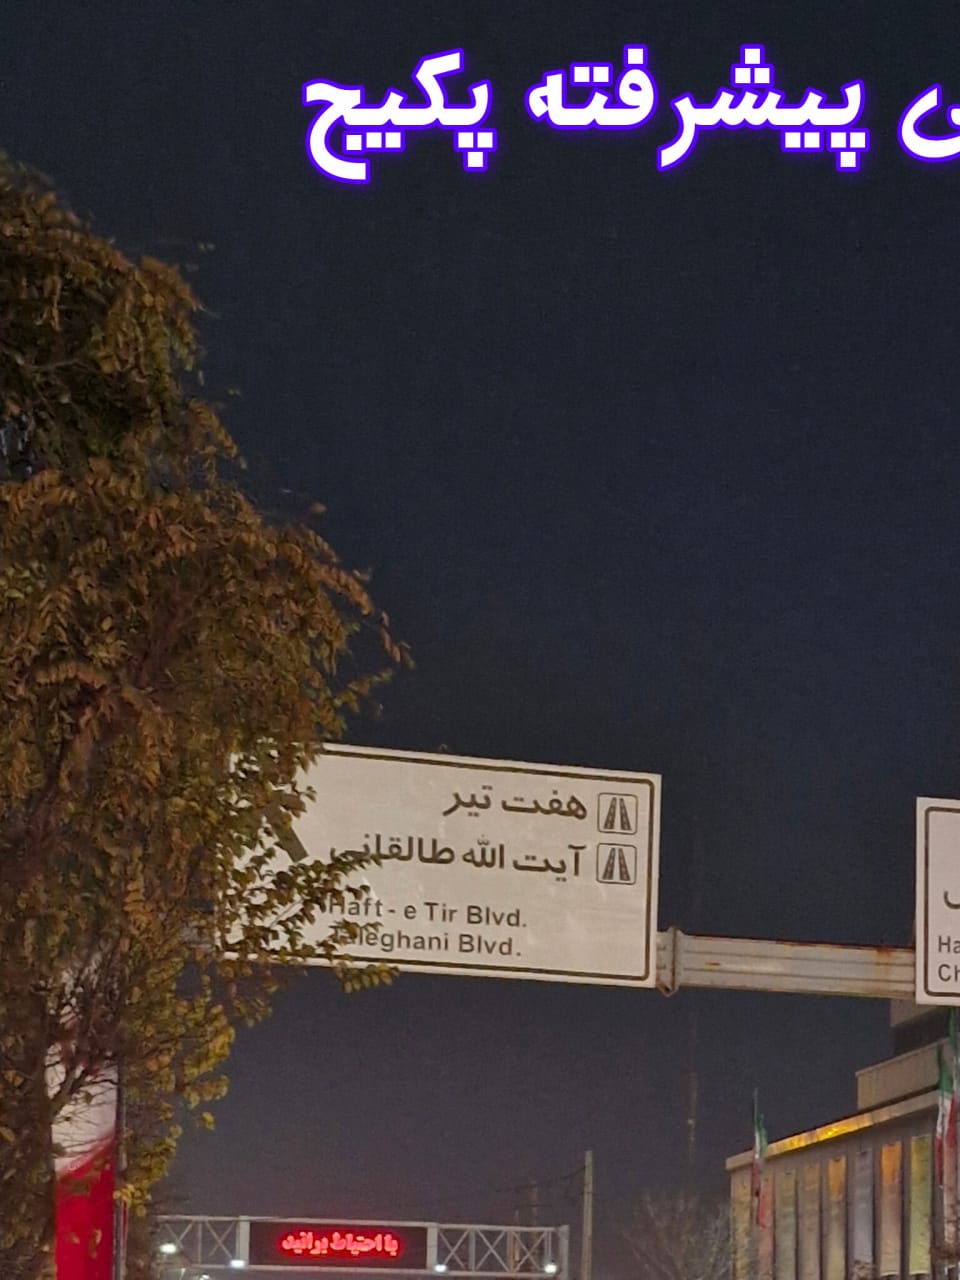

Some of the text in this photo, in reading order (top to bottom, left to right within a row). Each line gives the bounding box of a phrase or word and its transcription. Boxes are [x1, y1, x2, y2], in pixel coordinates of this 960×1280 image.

[442, 784, 588, 820] هفت تیر
[512, 844, 587, 882] آیت
[423, 902, 458, 923] Tir
[466, 905, 527, 928] Blvd.
[459, 933, 521, 957] Blvd.
[330, 1230, 384, 1256] احتیاط
